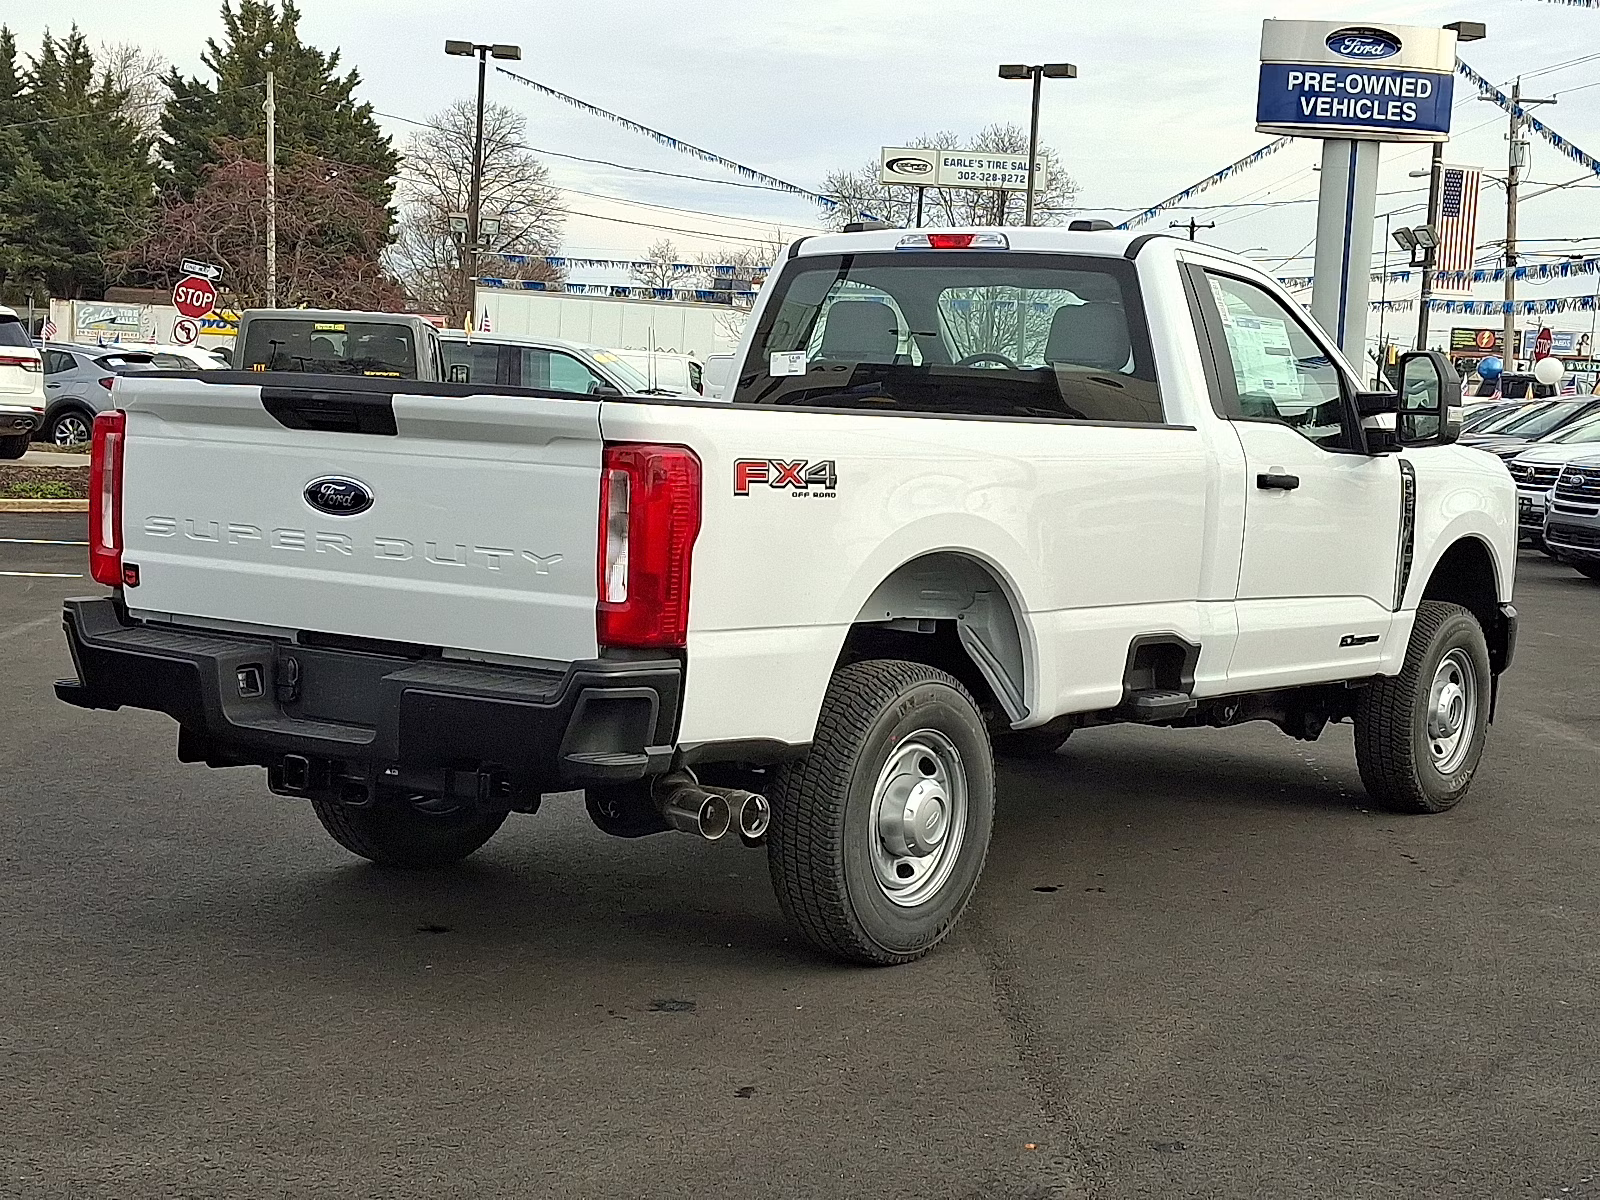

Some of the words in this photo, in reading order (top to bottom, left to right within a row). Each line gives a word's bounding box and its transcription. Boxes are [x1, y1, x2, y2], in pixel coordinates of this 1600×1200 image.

[1340, 37, 1385, 56] Ford
[1287, 71, 1433, 99] PRE-OWNED
[1300, 96, 1418, 122] VEHICLES
[943, 157, 984, 169] EARLE'S
[986, 160, 1008, 170] TIRE
[1010, 161, 1041, 172] SALS
[957, 171, 1026, 184] 302-328-8272
[176, 286, 213, 308] STOP
[1536, 339, 1551, 354] STOP
[733, 457, 838, 497] FX4
[318, 483, 355, 507] Ford
[791, 491, 810, 499] OFF
[812, 491, 837, 499] ROAD
[144, 515, 353, 556] SUPER
[374, 536, 563, 575] DUTY
